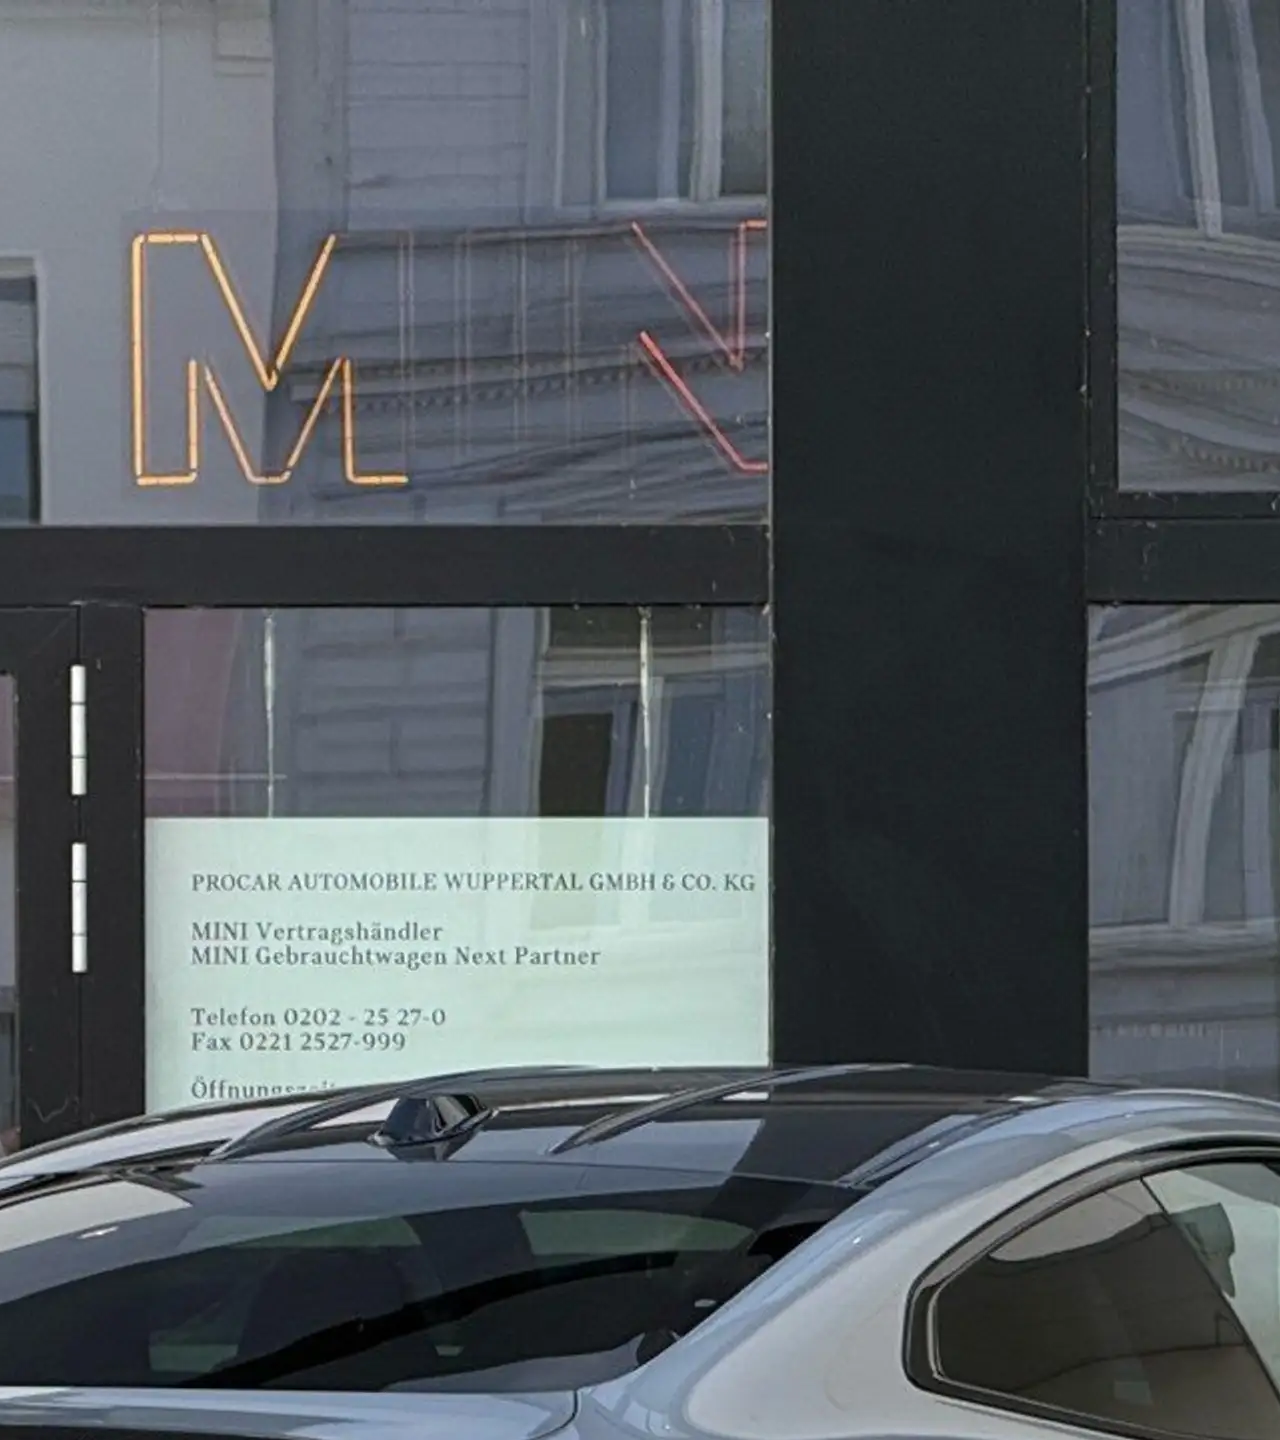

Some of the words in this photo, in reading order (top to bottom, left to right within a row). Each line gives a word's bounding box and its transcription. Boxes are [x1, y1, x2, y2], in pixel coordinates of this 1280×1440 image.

[191, 872, 282, 892] PROCAR
[287, 872, 437, 891] AUTOMOBILE
[444, 872, 584, 891] WUPPERTAL
[589, 872, 656, 891] GMBH
[662, 873, 676, 891] &
[681, 873, 717, 891] CO.
[723, 873, 756, 891] KG
[191, 921, 248, 941] MINI
[256, 920, 443, 945] Vertragshändler
[191, 946, 248, 965] MINI
[255, 946, 448, 970] Gebrauchtwagen
[455, 946, 507, 965] Next
[515, 946, 602, 965] Partner
[190, 1007, 276, 1026] Telefon
[283, 1008, 341, 1026] 0202
[363, 1008, 389, 1026] 25
[397, 1008, 446, 1026] 27-0
[190, 1032, 232, 1051] Fax
[239, 1032, 291, 1051] 0221
[300, 1032, 407, 1052] 2527-999
